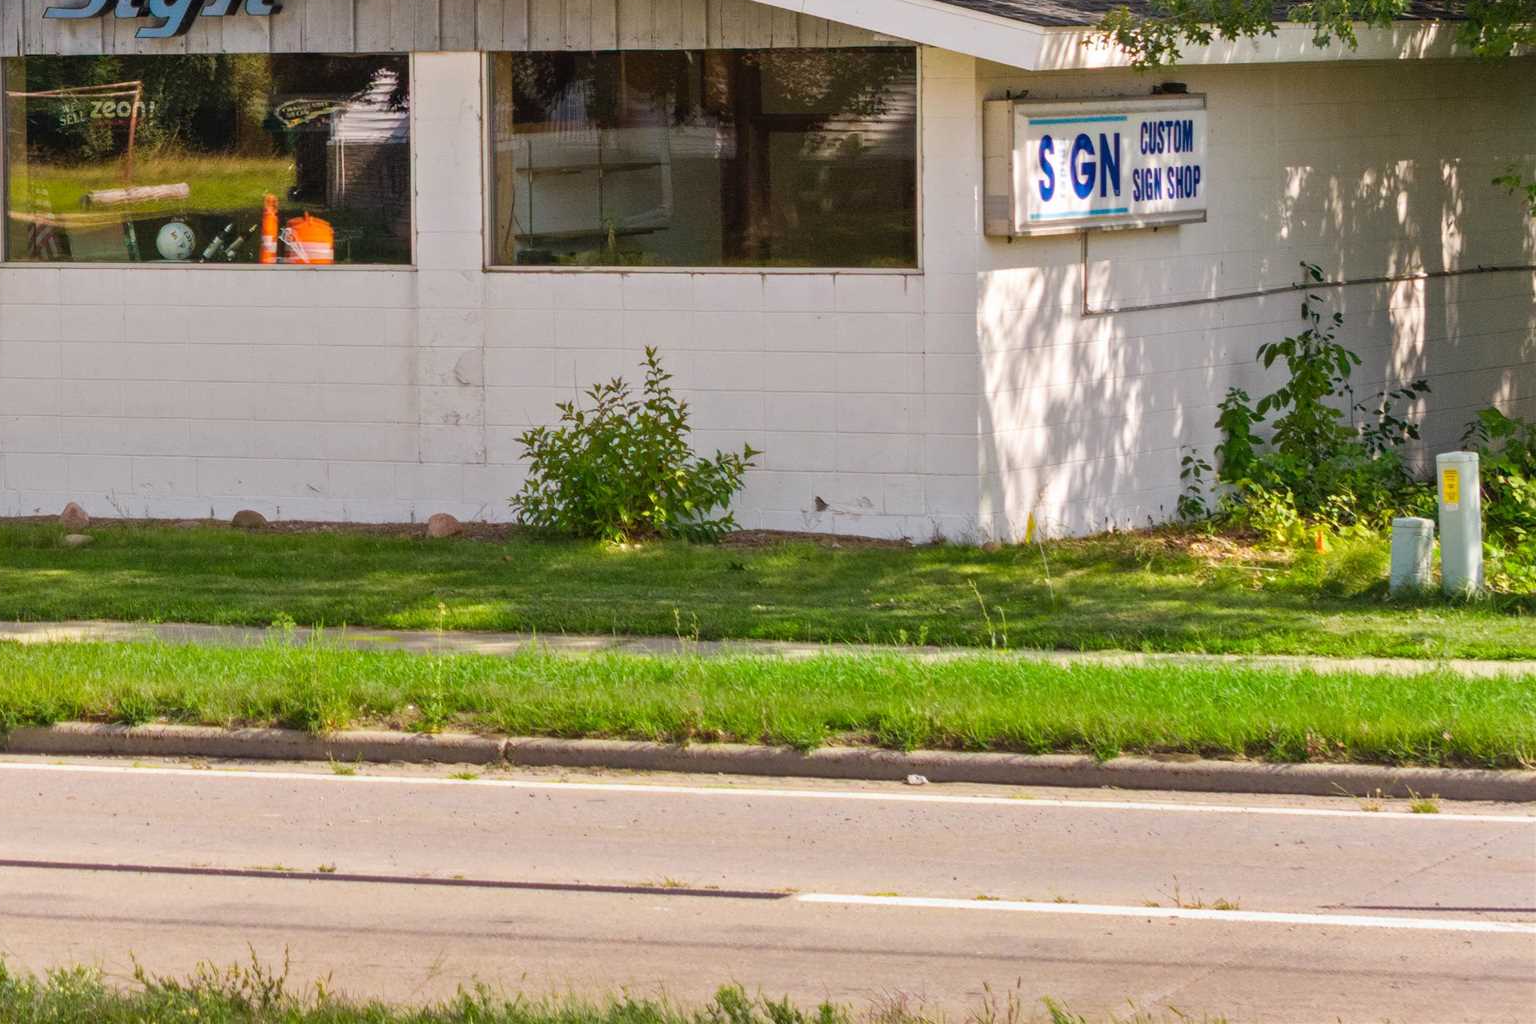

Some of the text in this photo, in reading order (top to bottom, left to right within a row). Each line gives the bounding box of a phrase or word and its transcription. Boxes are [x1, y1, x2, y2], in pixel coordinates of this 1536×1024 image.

[1140, 119, 1194, 155] CUSTOM
[1038, 132, 1121, 202] SGN
[1132, 164, 1201, 202] SIGN SHOP
